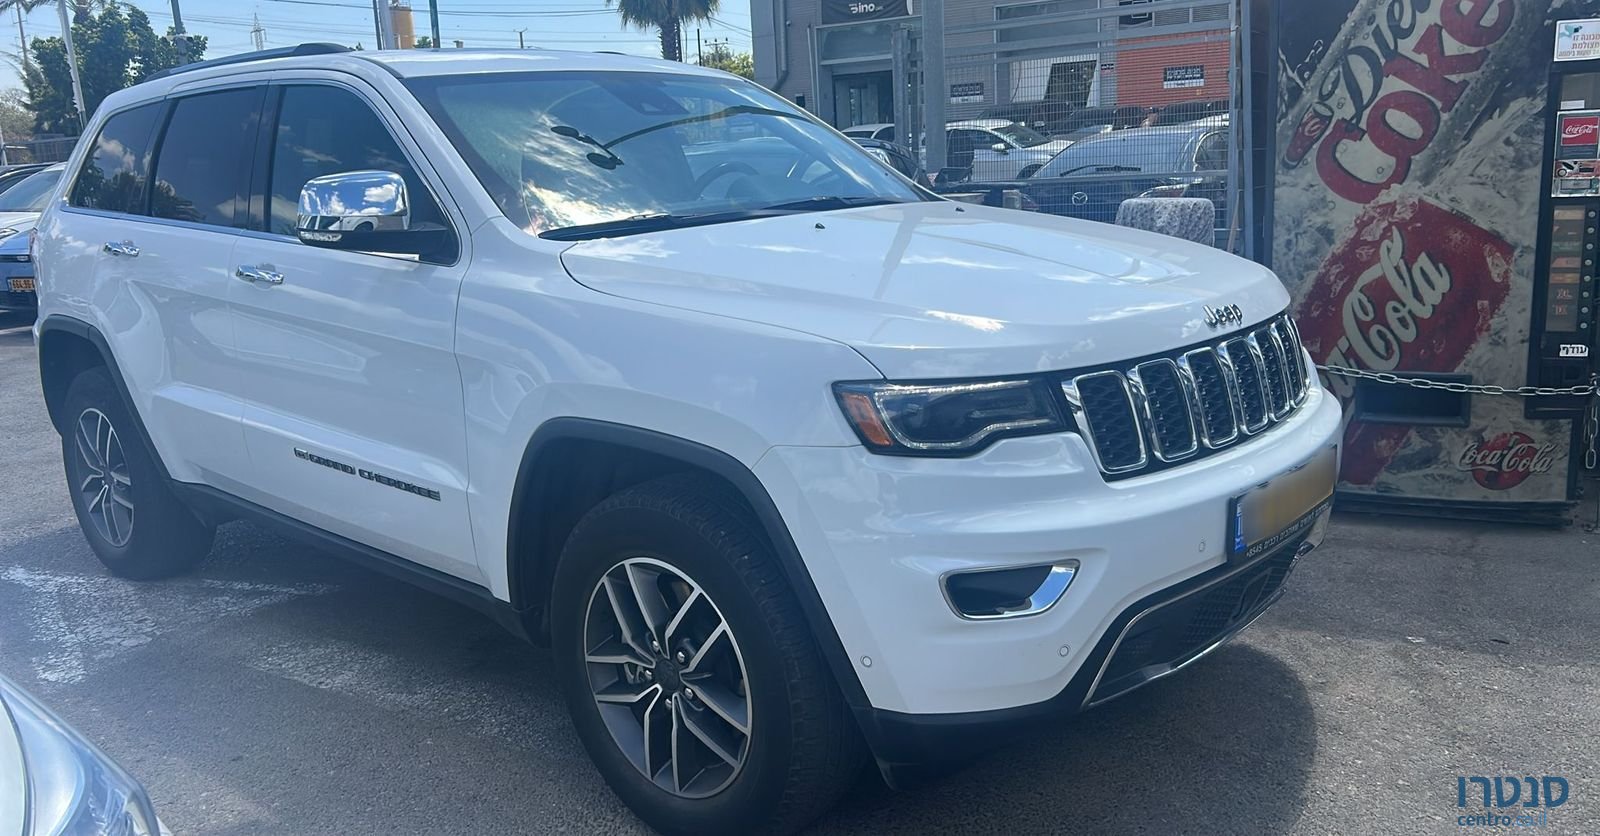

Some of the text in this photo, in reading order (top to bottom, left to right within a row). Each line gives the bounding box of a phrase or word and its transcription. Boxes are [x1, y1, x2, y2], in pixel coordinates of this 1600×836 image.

[1316, 0, 1516, 204] Coke
[1203, 304, 1242, 327] Jeep
[1562, 346, 1587, 355] עודף
[1458, 442, 1556, 473] Coca-Cola
[309, 454, 356, 475] GRAND
[358, 468, 441, 501] CHEROKEE
